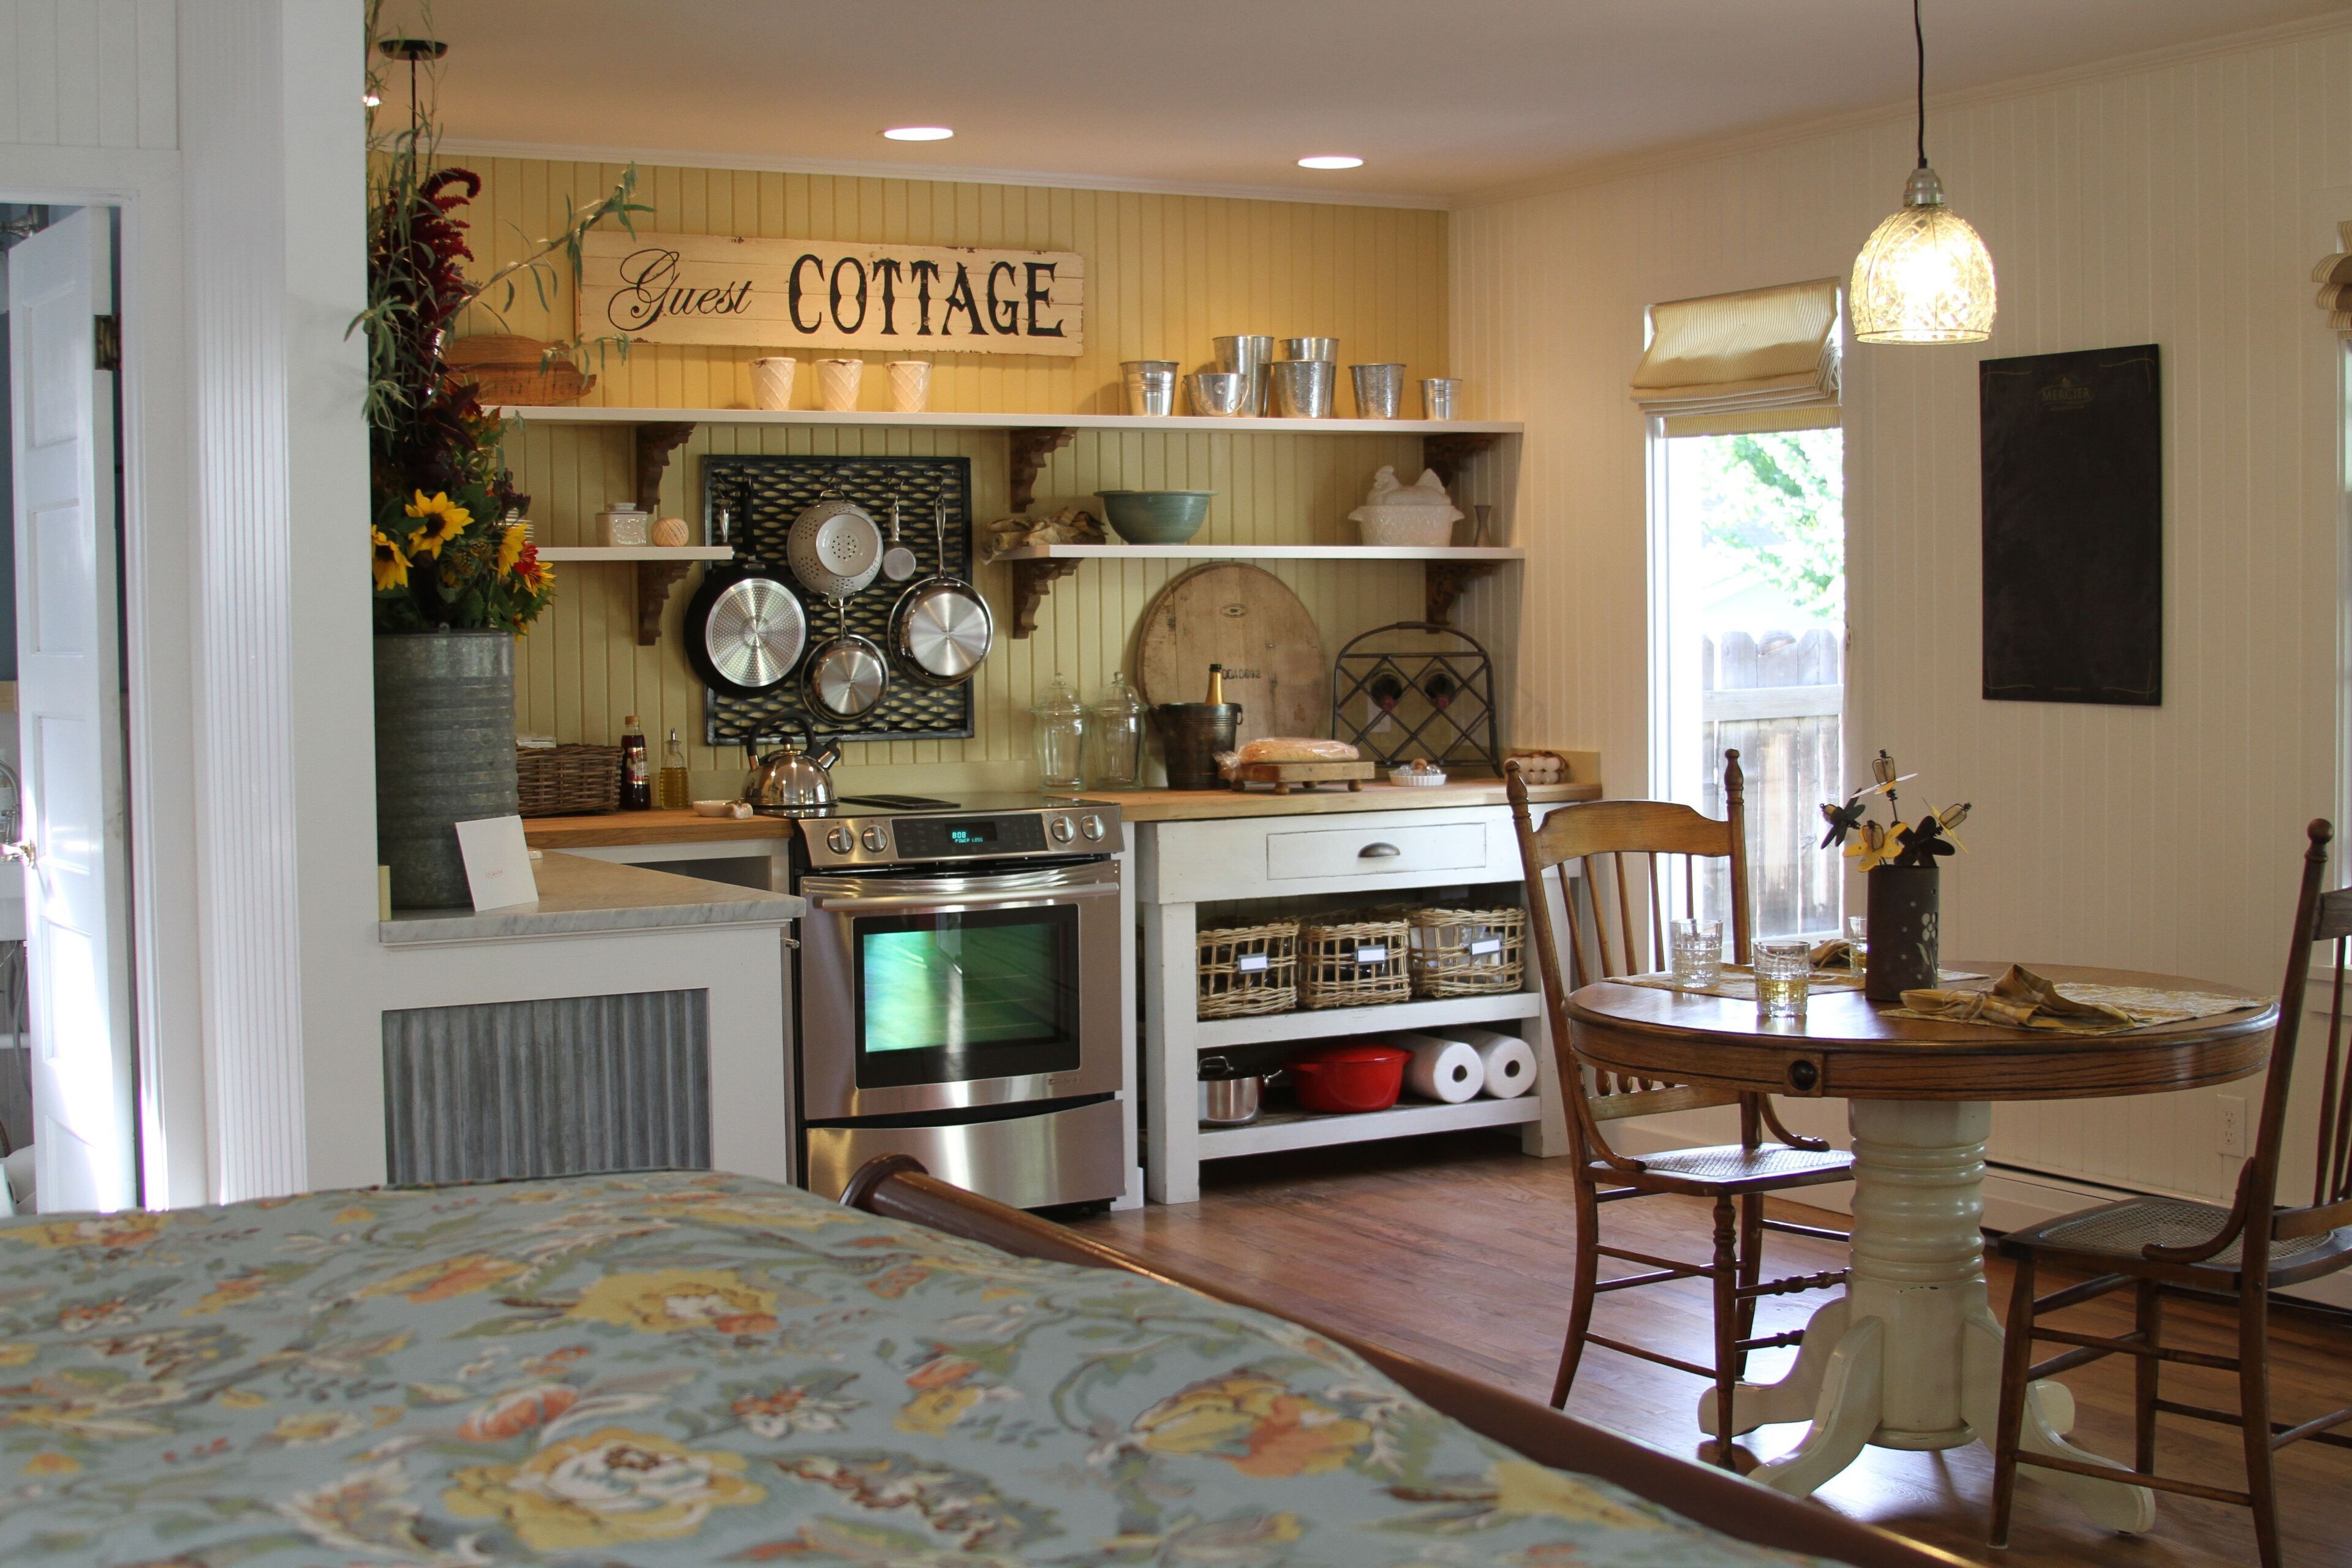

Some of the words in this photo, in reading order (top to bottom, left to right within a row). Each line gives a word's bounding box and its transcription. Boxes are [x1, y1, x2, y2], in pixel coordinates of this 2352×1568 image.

[608, 247, 753, 331] Guest
[788, 254, 1066, 337] COTTAGE
[2041, 387, 2090, 402] MERCIER
